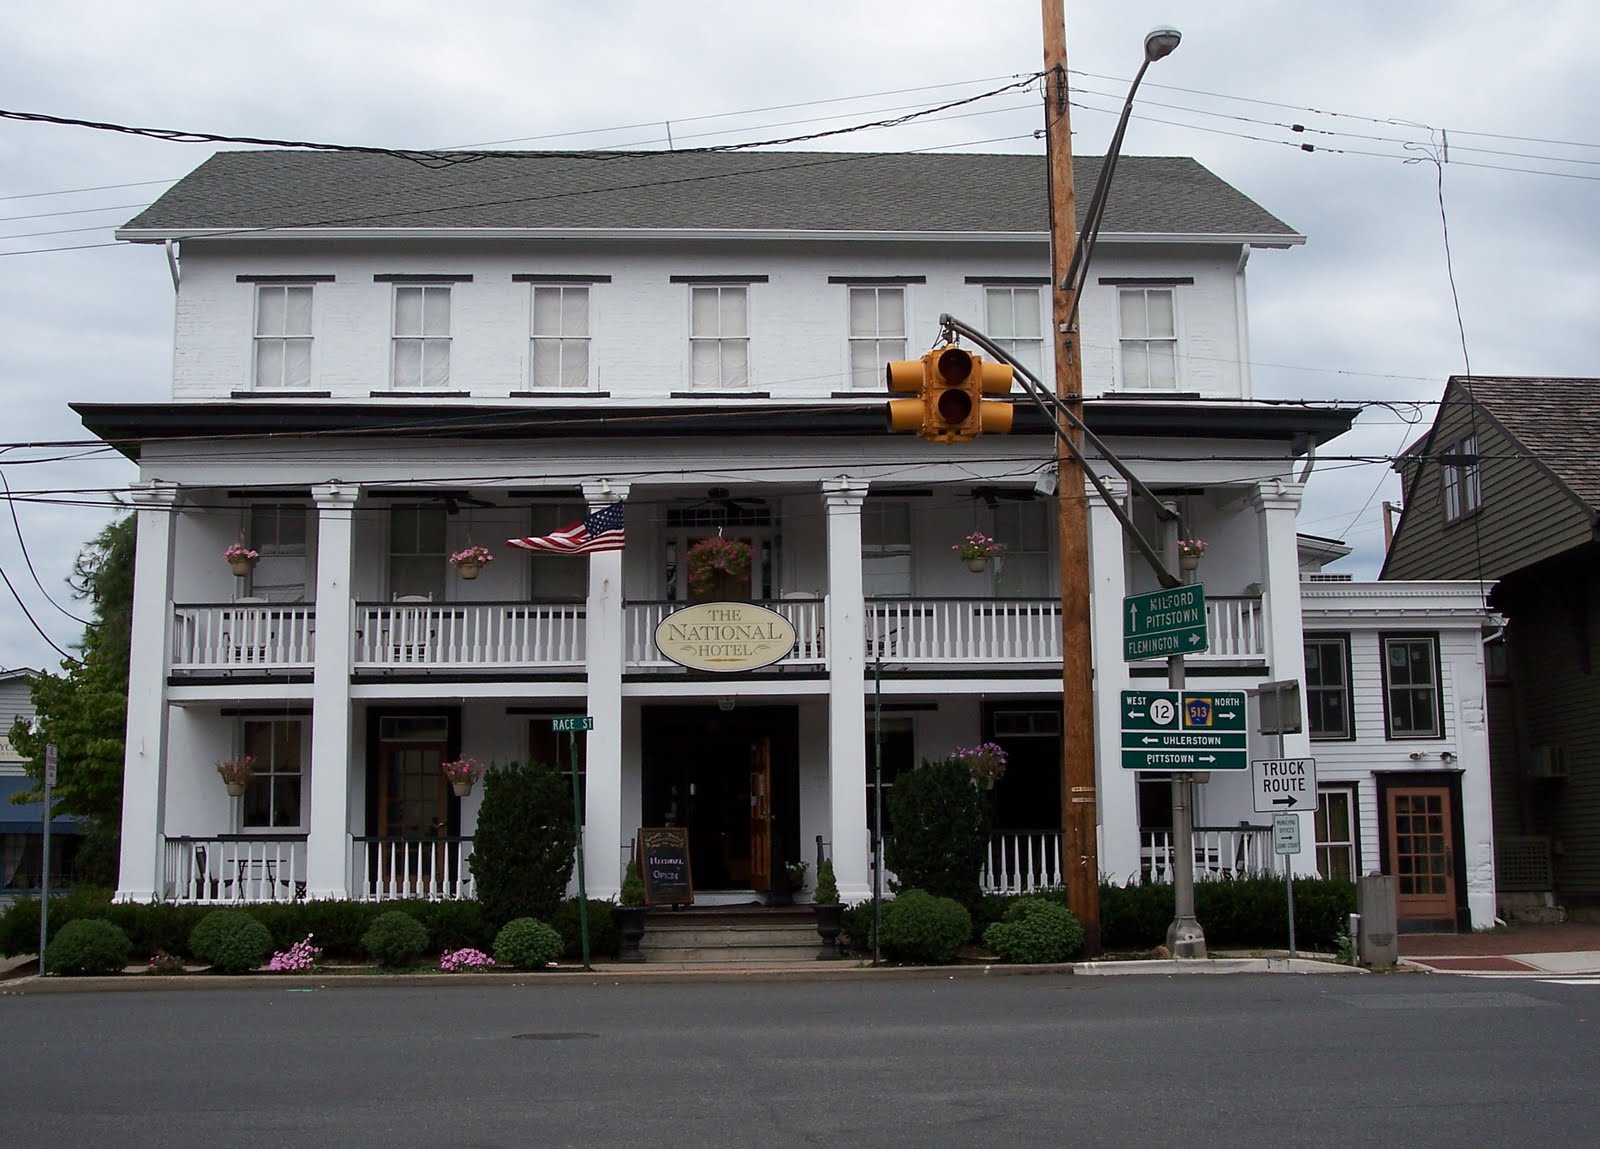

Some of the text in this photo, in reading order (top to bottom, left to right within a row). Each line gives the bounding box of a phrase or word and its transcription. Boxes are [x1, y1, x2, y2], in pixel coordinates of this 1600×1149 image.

[1150, 592, 1194, 611] MILFORD
[708, 609, 742, 622] THE
[1146, 608, 1198, 628] PITTSTOWN
[668, 622, 783, 641] NATIONAL
[698, 644, 754, 657] HOTEL
[1128, 635, 1179, 654] FLEMINGTON
[1126, 696, 1147, 706] WEST
[1214, 697, 1240, 707] NORTH
[1153, 705, 1170, 719] 12
[1190, 706, 1207, 718] 513
[552, 718, 592, 730] RACE ST
[1163, 736, 1221, 745] UHLERSTOWN
[1146, 754, 1194, 764] PITTSTOWN
[1262, 761, 1305, 776] TRUCK
[1263, 777, 1306, 793] ROUTE
